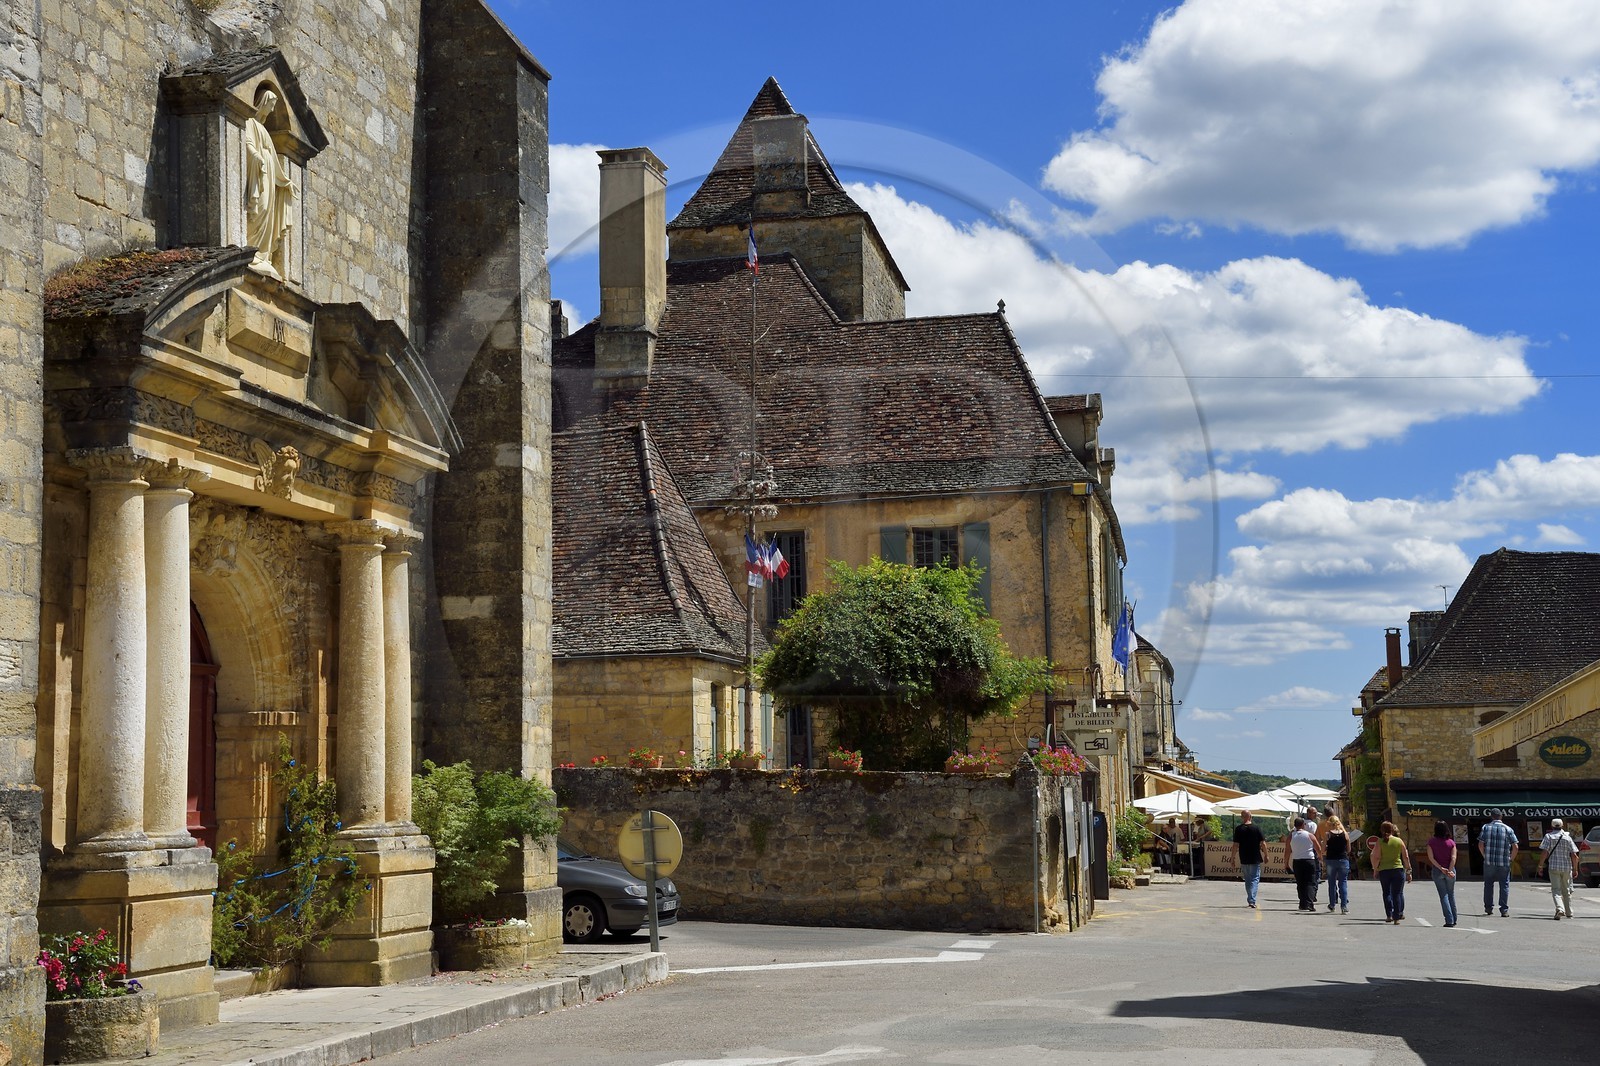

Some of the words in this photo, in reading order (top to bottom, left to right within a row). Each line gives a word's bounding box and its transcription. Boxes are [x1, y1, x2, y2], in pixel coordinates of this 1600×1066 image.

[1452, 808, 1480, 817] FOIE
[1483, 808, 1515, 817] GAS
[1211, 865, 1243, 873] Brasseri
